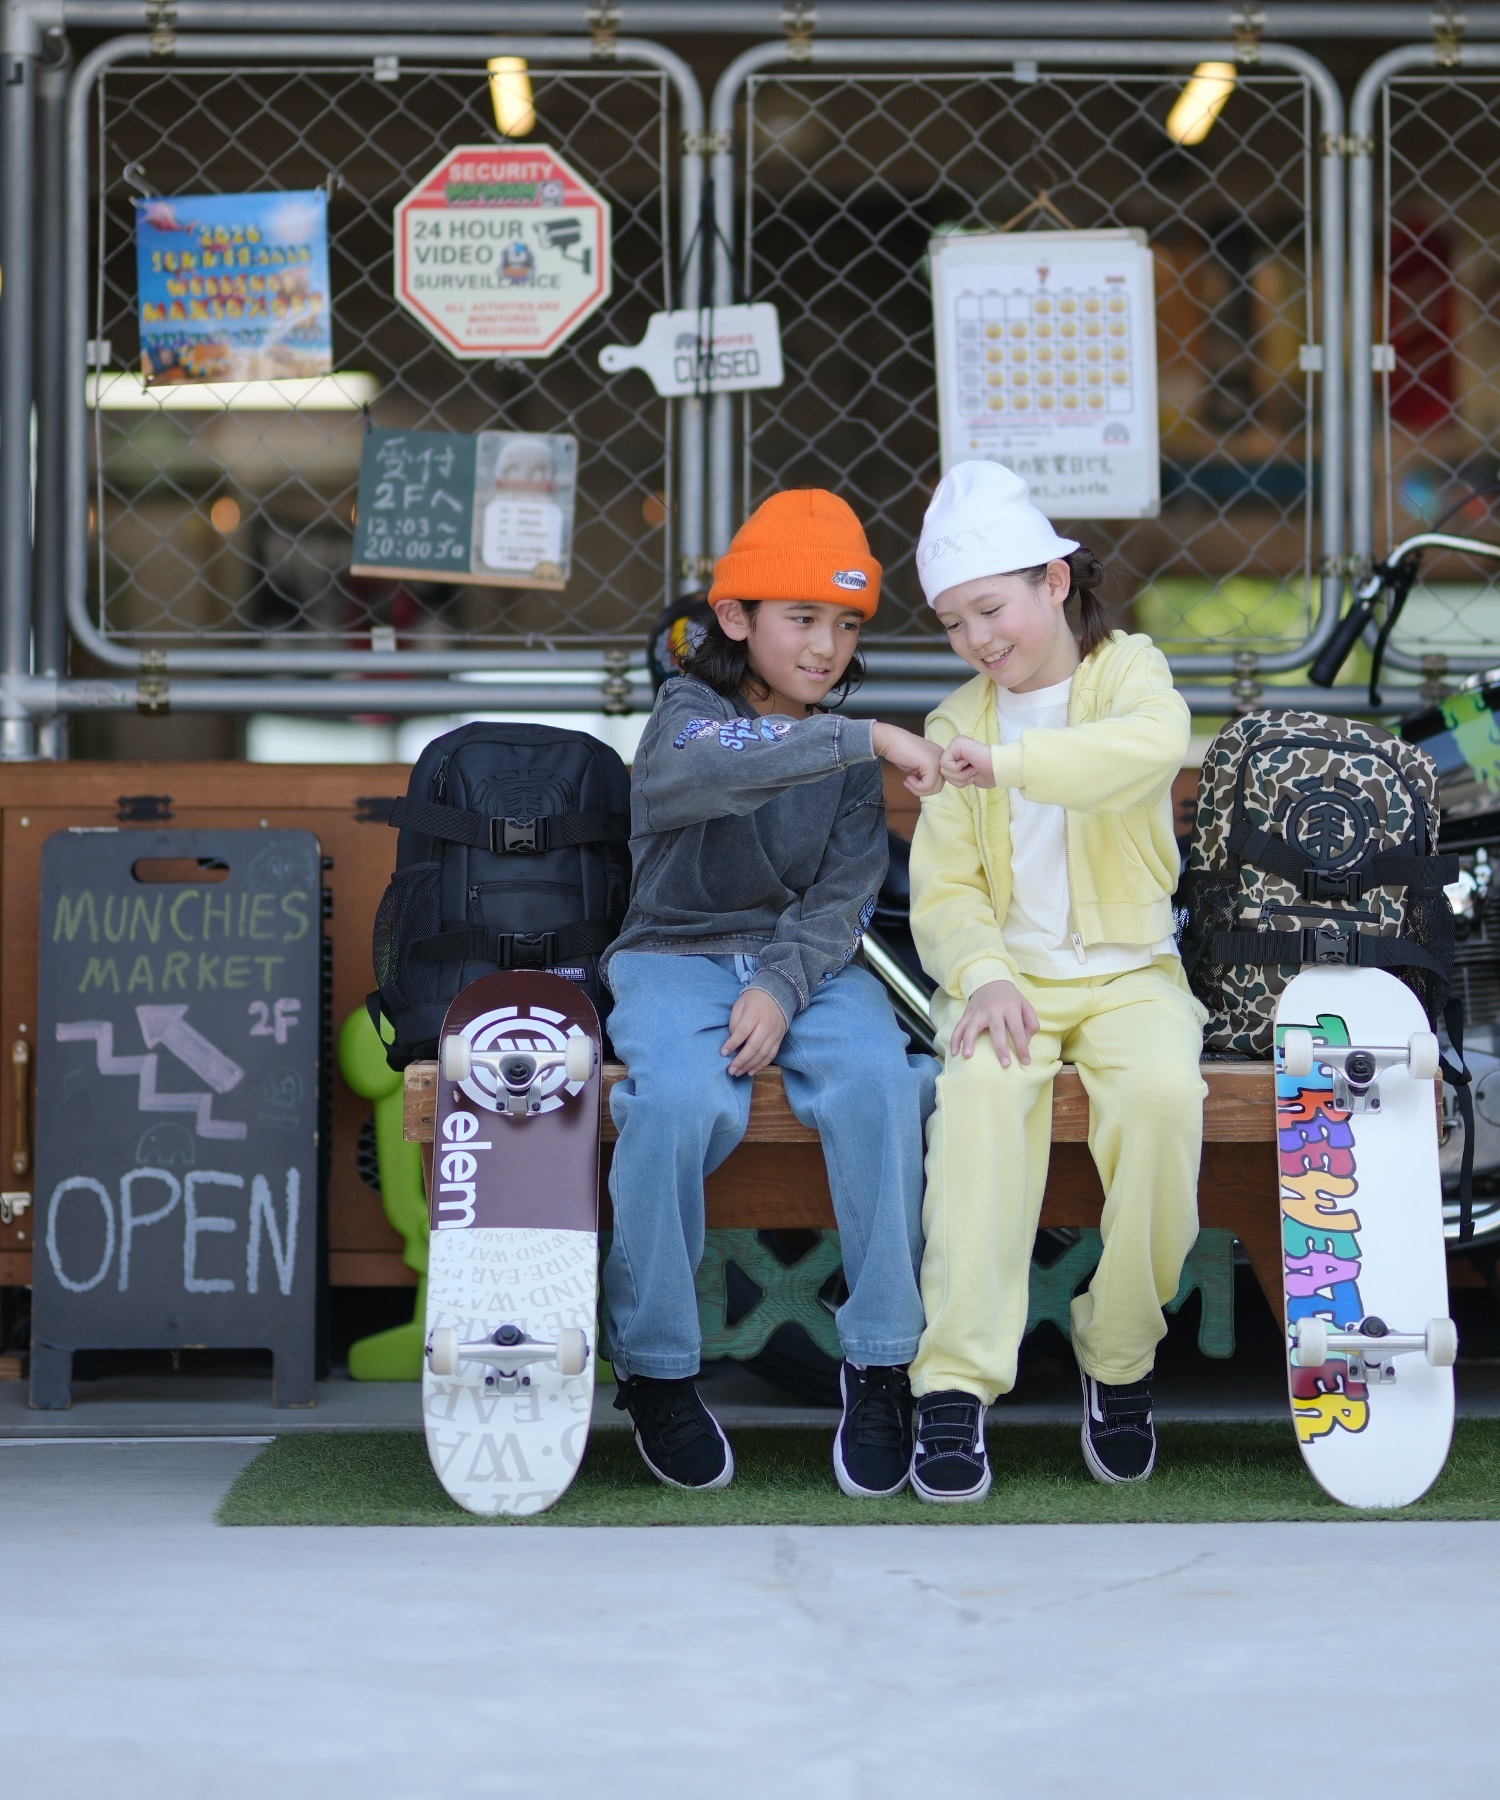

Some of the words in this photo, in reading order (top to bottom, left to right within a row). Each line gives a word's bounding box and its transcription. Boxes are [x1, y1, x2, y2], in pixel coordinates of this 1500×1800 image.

[448, 161, 554, 181] SECURITY
[414, 219, 442, 240] 24
[450, 219, 524, 240] HOUR
[415, 245, 494, 265] VIDEO
[413, 273, 561, 290] SURVEILLNCE
[445, 302, 466, 313] ALL
[472, 302, 535, 313] ACTIVITIES
[537, 301, 560, 312] ARE
[468, 314, 538, 324] MONITORED
[475, 326, 541, 336] RECORDED
[674, 349, 760, 384] CLOSED
[376, 436, 456, 484] 受付
[919, 523, 998, 568] OXY
[53, 889, 309, 943] MUNCHIES
[78, 951, 286, 994] MARKET
[247, 997, 301, 1044] 2F
[45, 1167, 301, 1295] OPEN
